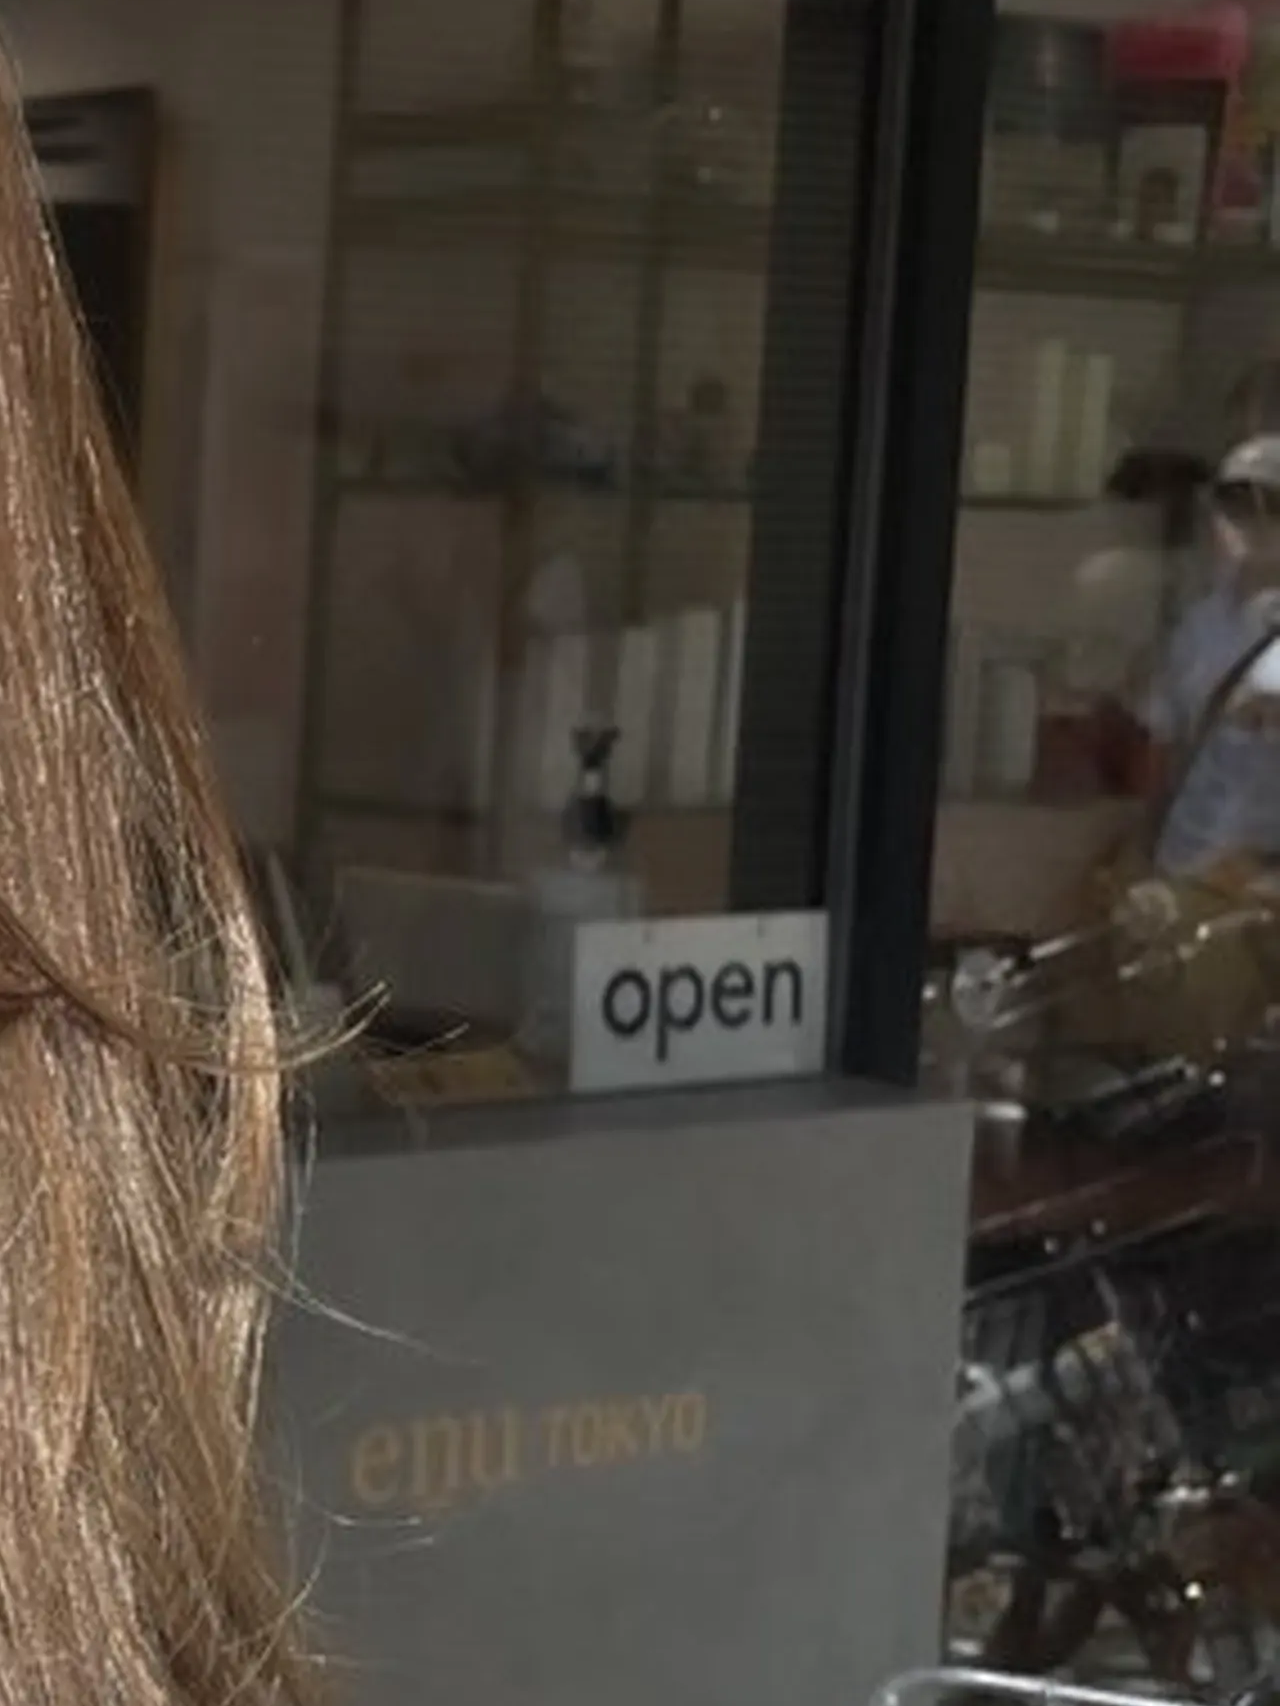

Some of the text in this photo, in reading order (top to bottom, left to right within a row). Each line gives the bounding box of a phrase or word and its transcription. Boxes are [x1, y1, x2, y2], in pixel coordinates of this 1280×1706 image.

[603, 960, 802, 1061] open
[352, 1392, 706, 1508] enu TOKYO
